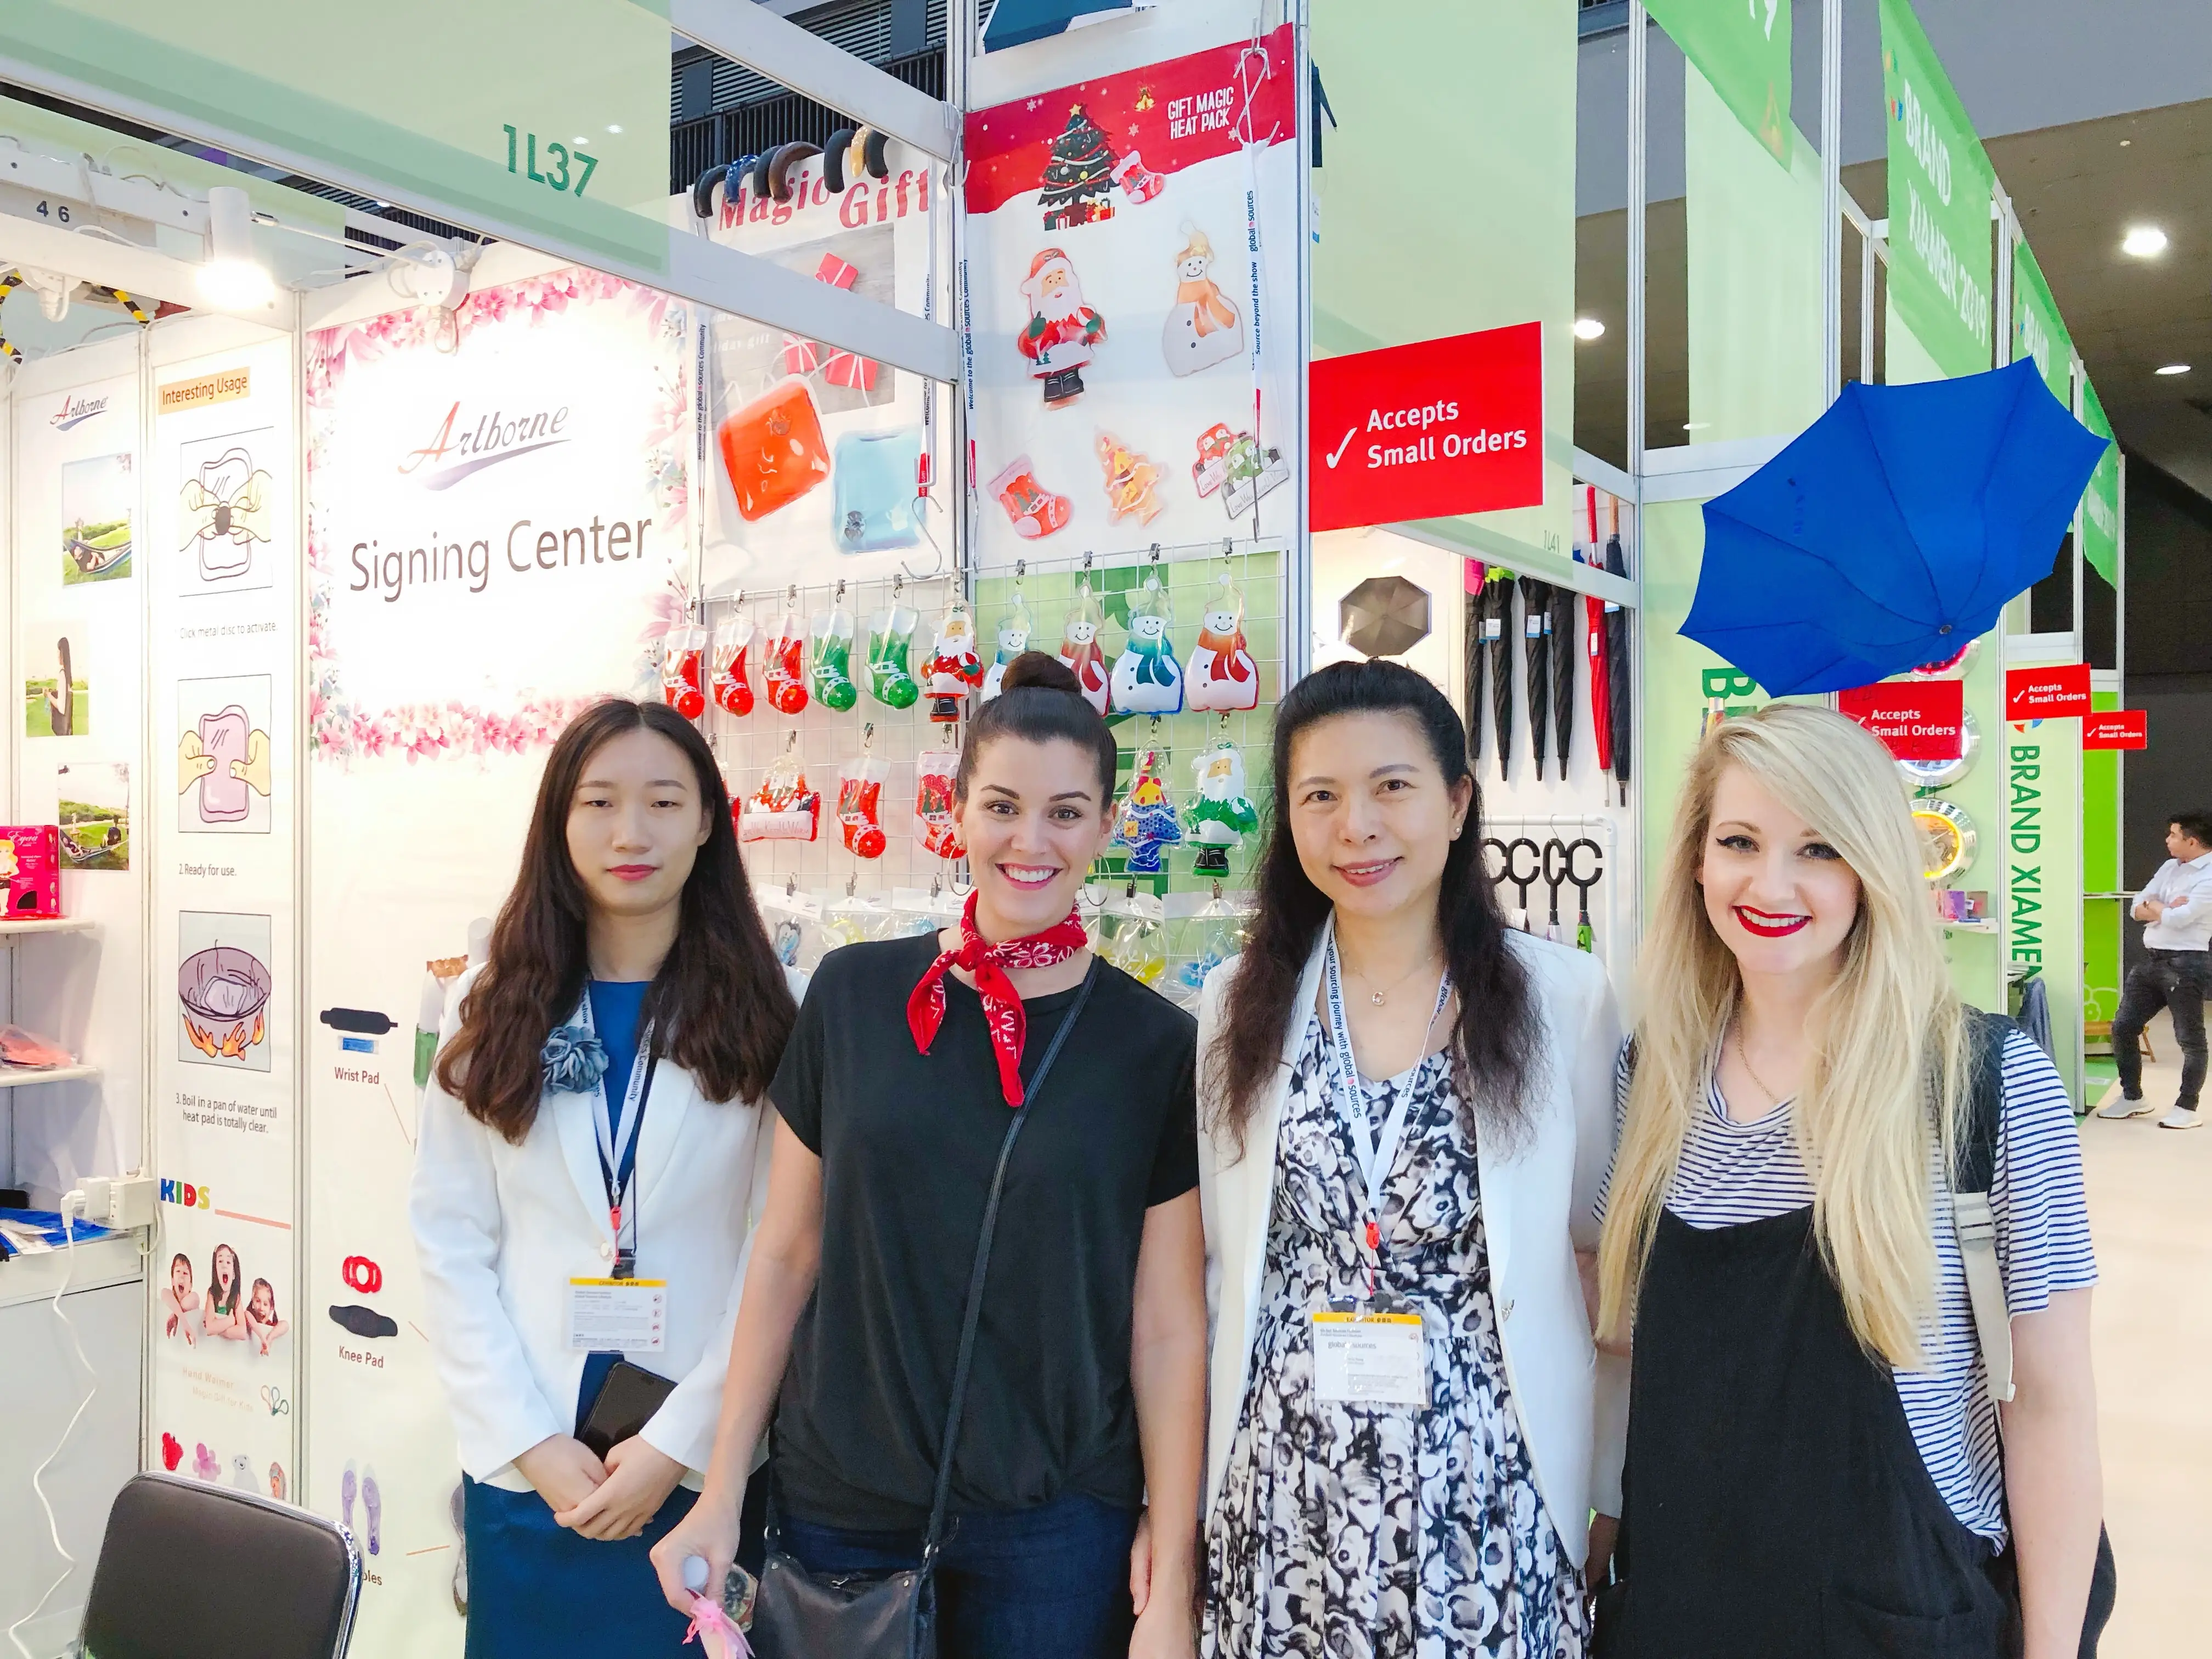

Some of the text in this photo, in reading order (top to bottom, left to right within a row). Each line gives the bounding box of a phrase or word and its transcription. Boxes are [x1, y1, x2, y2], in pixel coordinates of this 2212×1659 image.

[1167, 86, 1234, 120] GIFT MAGIC
[1170, 107, 1231, 140] HEAT PACK
[1904, 78, 1951, 206] BRAND
[503, 124, 599, 198] 1L37
[839, 168, 928, 228] Gift
[1907, 178, 1987, 347] XIAMEN 2019
[698, 324, 707, 359] Community
[162, 376, 247, 405] Interesting Usage
[1367, 400, 1459, 432] Accepts
[1367, 429, 1527, 468] Small Orders
[350, 515, 652, 603] Signing Center
[198, 625, 218, 636] metal
[221, 625, 235, 635] disc
[237, 625, 245, 634] to
[2028, 684, 2062, 693] Accepts
[2028, 693, 2086, 704] Small Orders
[1871, 709, 1921, 722] Accepts
[1871, 725, 1956, 736] Small Orders
[2011, 745, 2041, 854] BRAND
[184, 864, 206, 878] Ready
[208, 864, 219, 876] for
[221, 867, 237, 876] use.
[1327, 946, 1336, 964] your
[1330, 966, 1340, 1000] sourcing
[1331, 1001, 1342, 1030] journey
[1338, 1031, 1348, 1049] with
[334, 1066, 379, 1085] Wrist Pad
[629, 1054, 647, 1102] Community
[176, 1092, 277, 1118] 3. Boil in a pan of water until
[183, 1109, 269, 1133] heat pad is totally clear.
[160, 1178, 210, 1210] KIDS
[339, 1345, 383, 1368] Knee Pad
